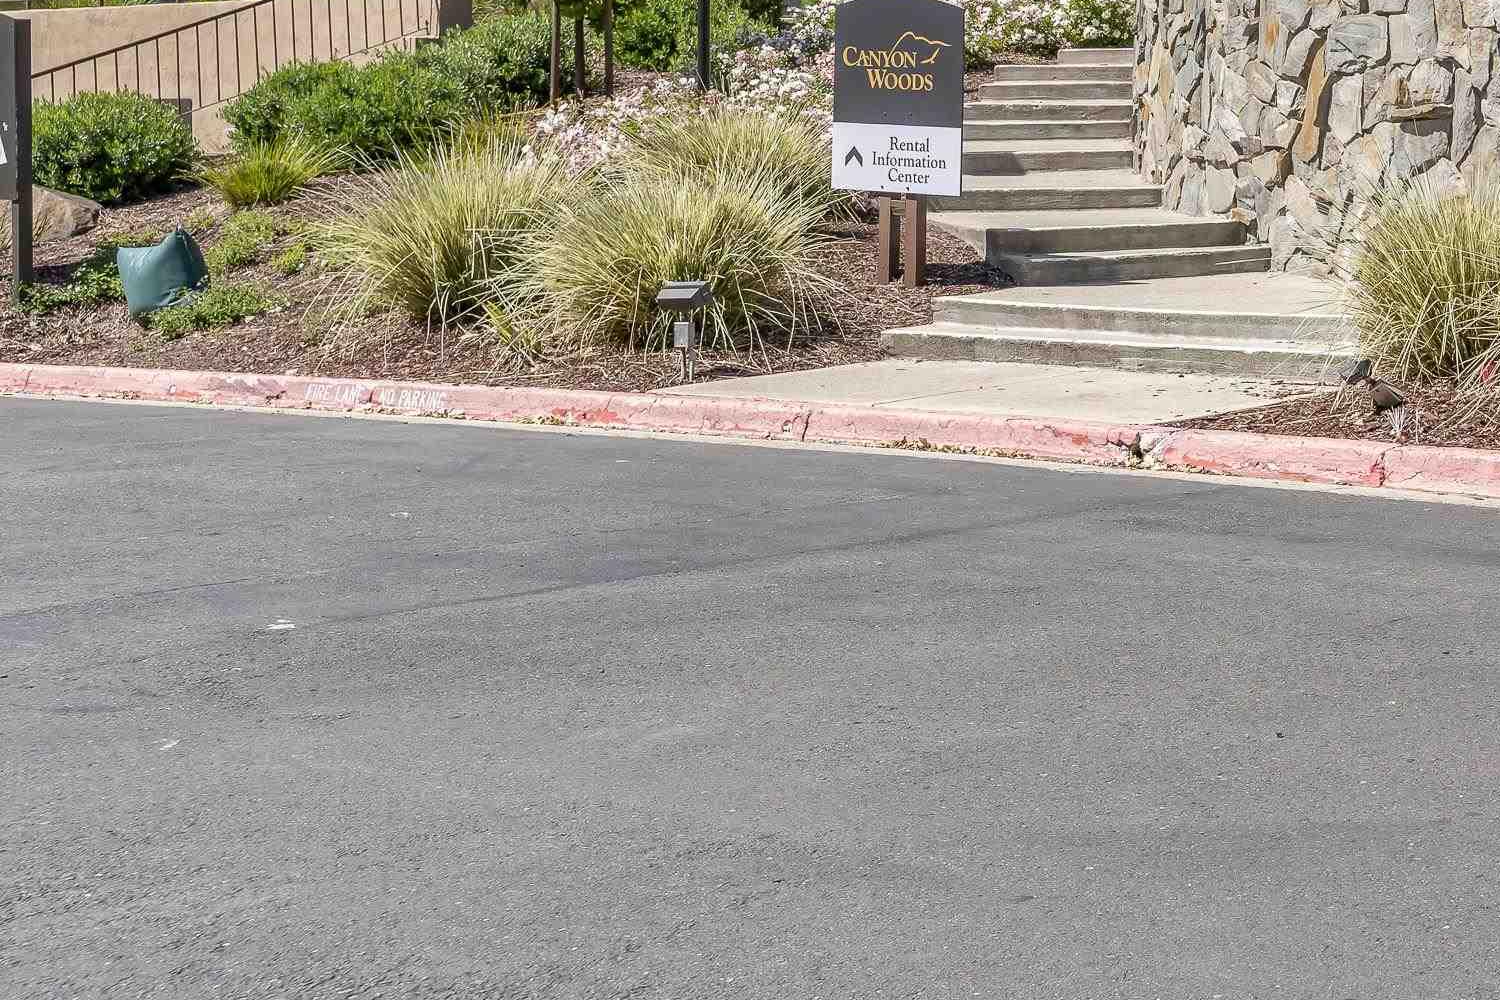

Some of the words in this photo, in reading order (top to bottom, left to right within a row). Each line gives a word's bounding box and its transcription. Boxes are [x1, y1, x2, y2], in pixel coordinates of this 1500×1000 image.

[842, 46, 917, 68] CANYON
[866, 68, 934, 91] WOODS
[890, 136, 930, 152] Rental
[872, 151, 947, 169] Information
[887, 168, 930, 184] Center
[304, 383, 331, 401] FIRE
[398, 390, 448, 410] PARKING
